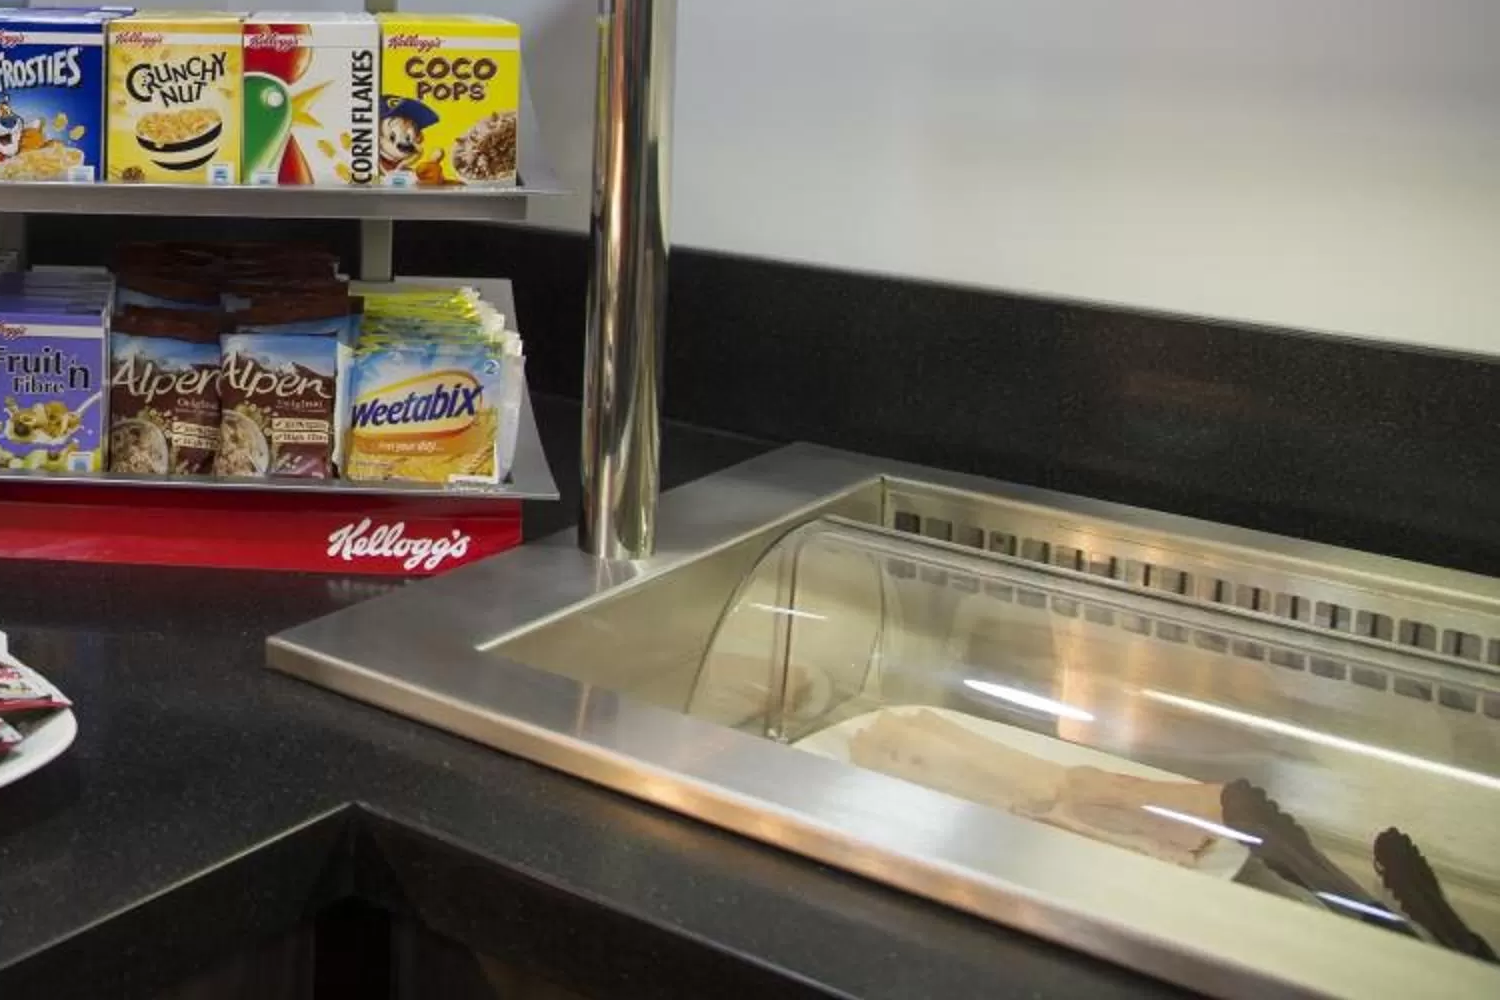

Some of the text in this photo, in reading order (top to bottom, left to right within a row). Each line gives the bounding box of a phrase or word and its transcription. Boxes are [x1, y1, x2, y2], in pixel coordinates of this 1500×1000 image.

[115, 31, 164, 50] Kellogg's
[250, 33, 300, 50] Kellogg's
[388, 32, 443, 51] Kellogg's
[126, 51, 227, 102] CRUNCHY
[404, 56, 498, 80] COCO
[160, 82, 207, 108] NUT
[416, 82, 486, 101] POPS
[352, 50, 373, 184] CORN FLAKES
[222, 350, 332, 399] Alpen
[484, 361, 498, 375] 2
[13, 375, 64, 394] Fibre
[351, 383, 484, 428] Weetabix
[327, 517, 470, 570] Kellogg's
